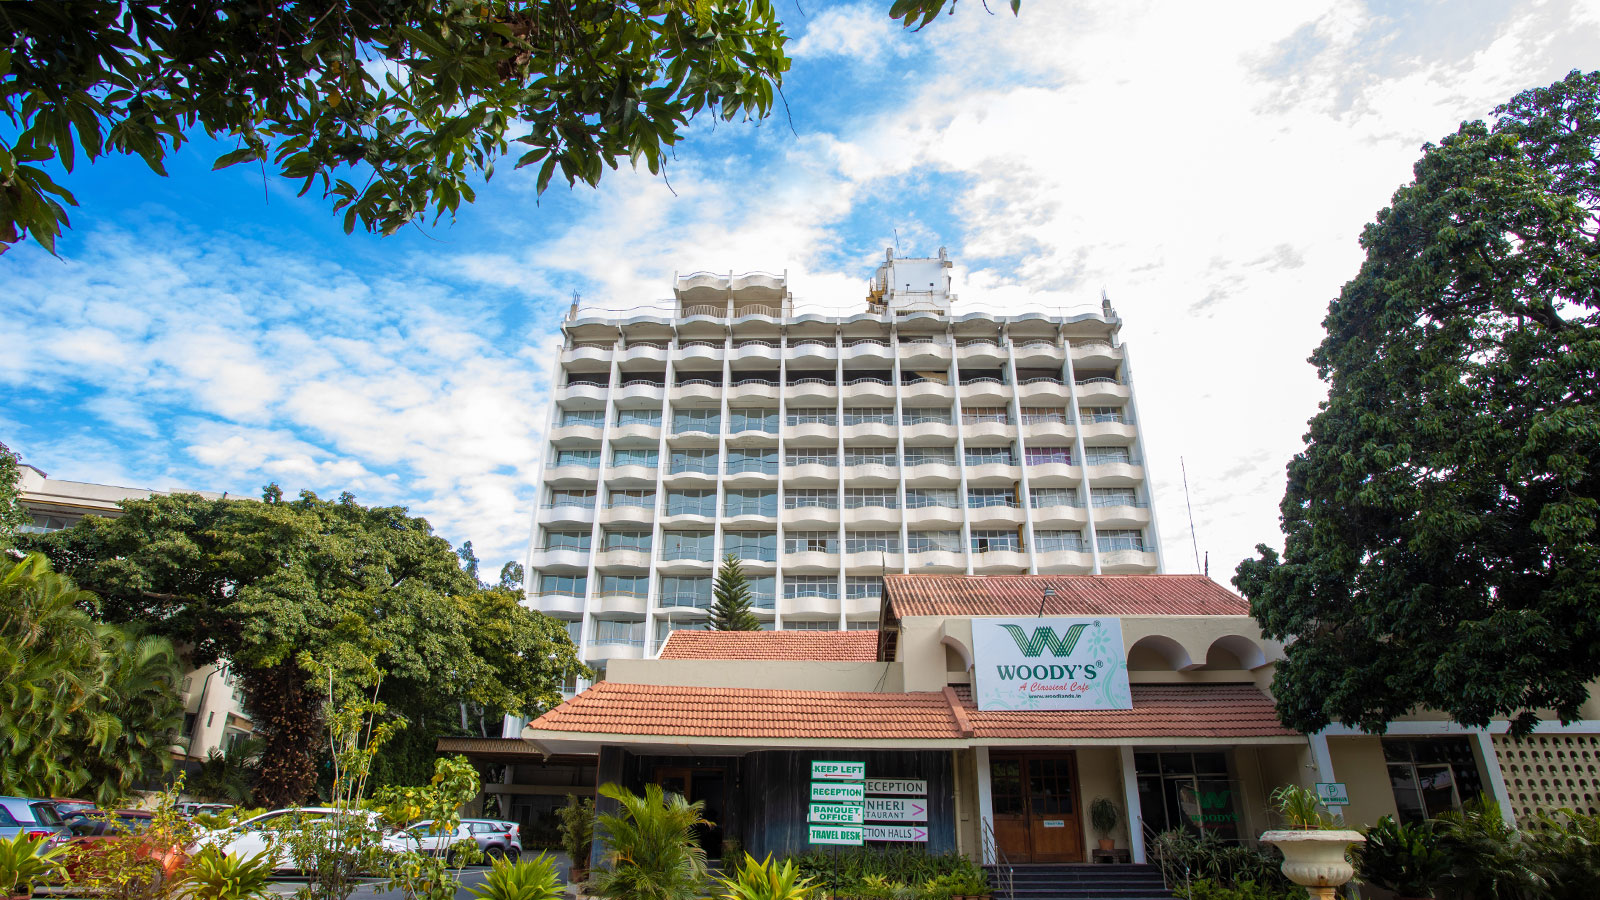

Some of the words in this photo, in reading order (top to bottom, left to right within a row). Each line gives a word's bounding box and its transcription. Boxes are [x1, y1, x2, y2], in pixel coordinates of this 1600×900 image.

[1018, 682, 1027, 692] A
[1030, 682, 1067, 692] Classical
[1070, 681, 1090, 693] Cafe
[814, 765, 838, 773] KEEP
[841, 766, 863, 774] LEFT
[812, 788, 861, 796] RECEPTION
[813, 806, 860, 814] BANQUET
[819, 813, 854, 821] OFFICE
[811, 830, 839, 840] TRAVEL
[841, 830, 861, 841] DESK
[888, 828, 912, 839] HALLS
